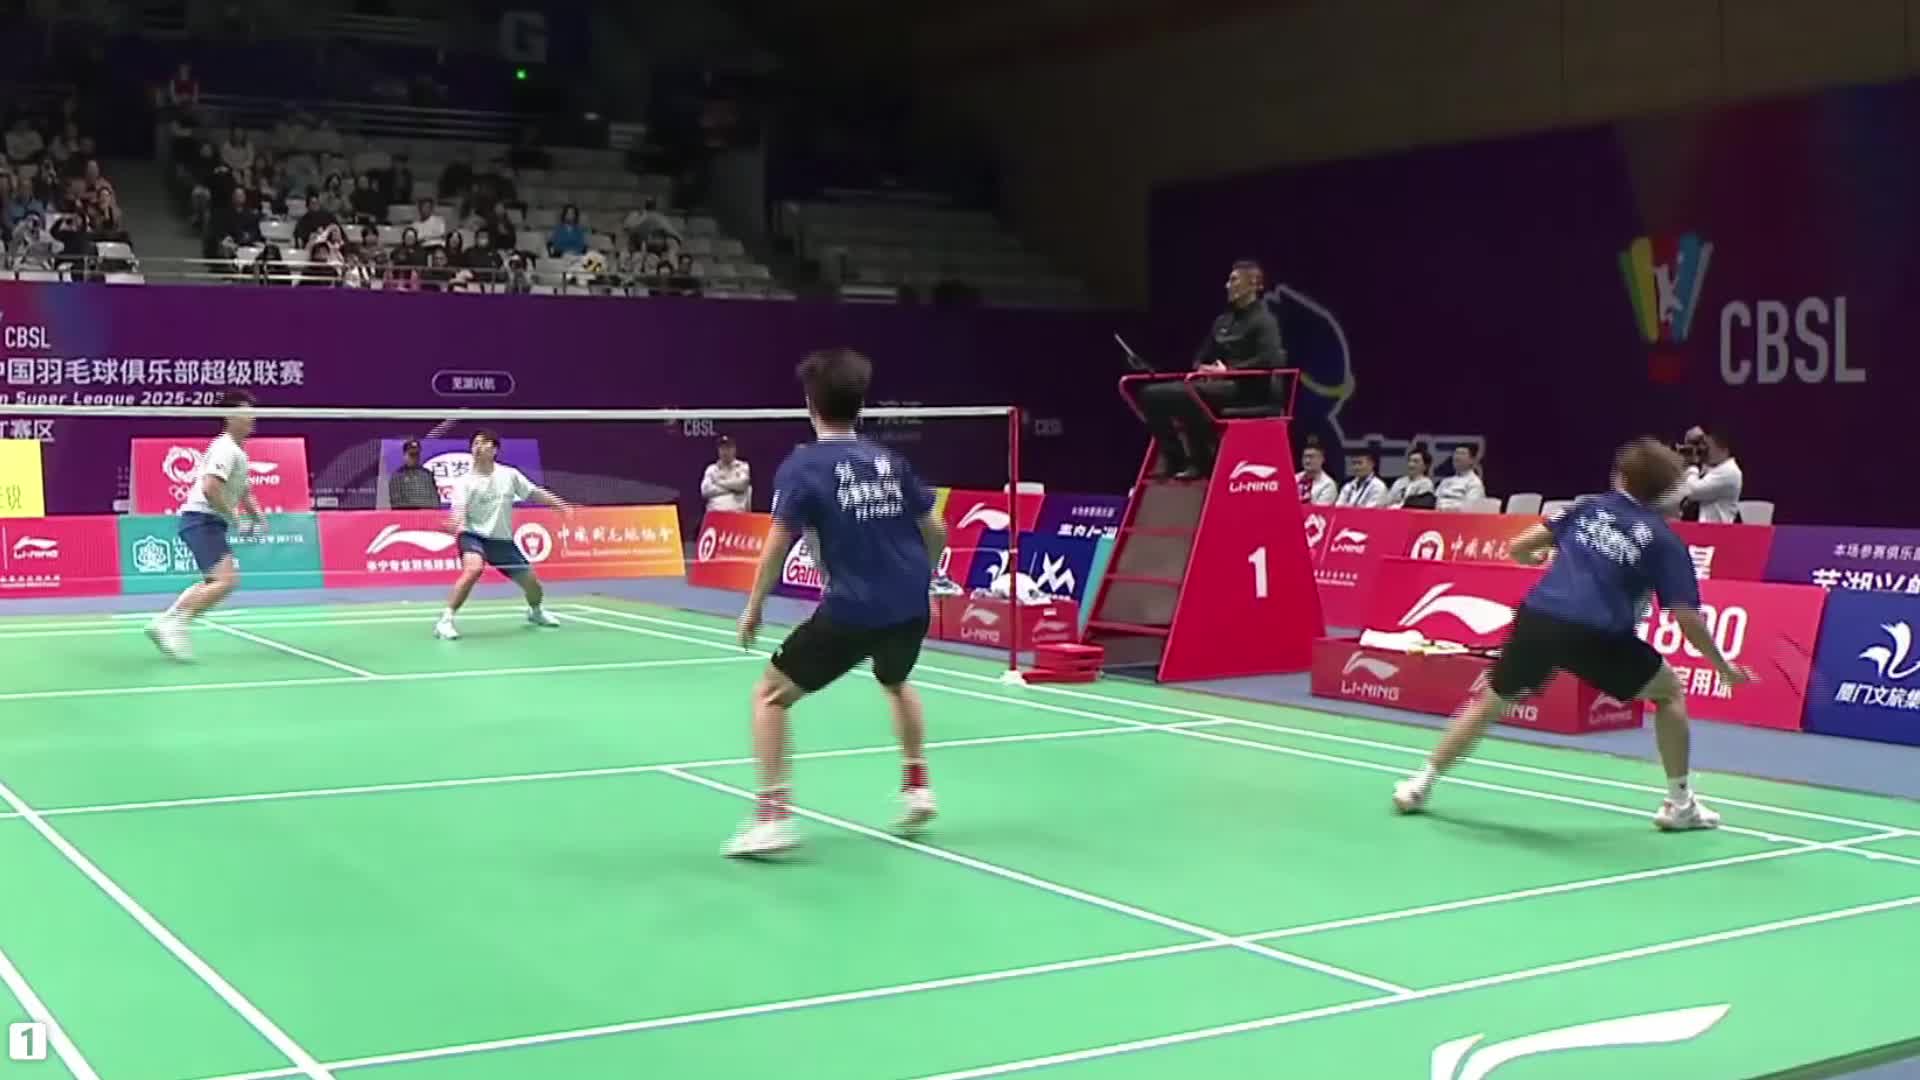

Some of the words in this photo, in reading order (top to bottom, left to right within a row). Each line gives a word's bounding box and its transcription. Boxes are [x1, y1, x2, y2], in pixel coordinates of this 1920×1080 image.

[5, 326, 51, 349] CBSL
[1720, 297, 1867, 385] CBSL
[0, 357, 304, 386] 国羽毛球俱乐部超级联赛
[16, 391, 67, 406] Super
[73, 391, 136, 406] League
[683, 418, 717, 436] CBSL
[432, 461, 470, 477] 百岁
[1229, 481, 1278, 492] LI-NING
[1248, 547, 1269, 598] 1
[1341, 680, 1399, 700] LI-NING
